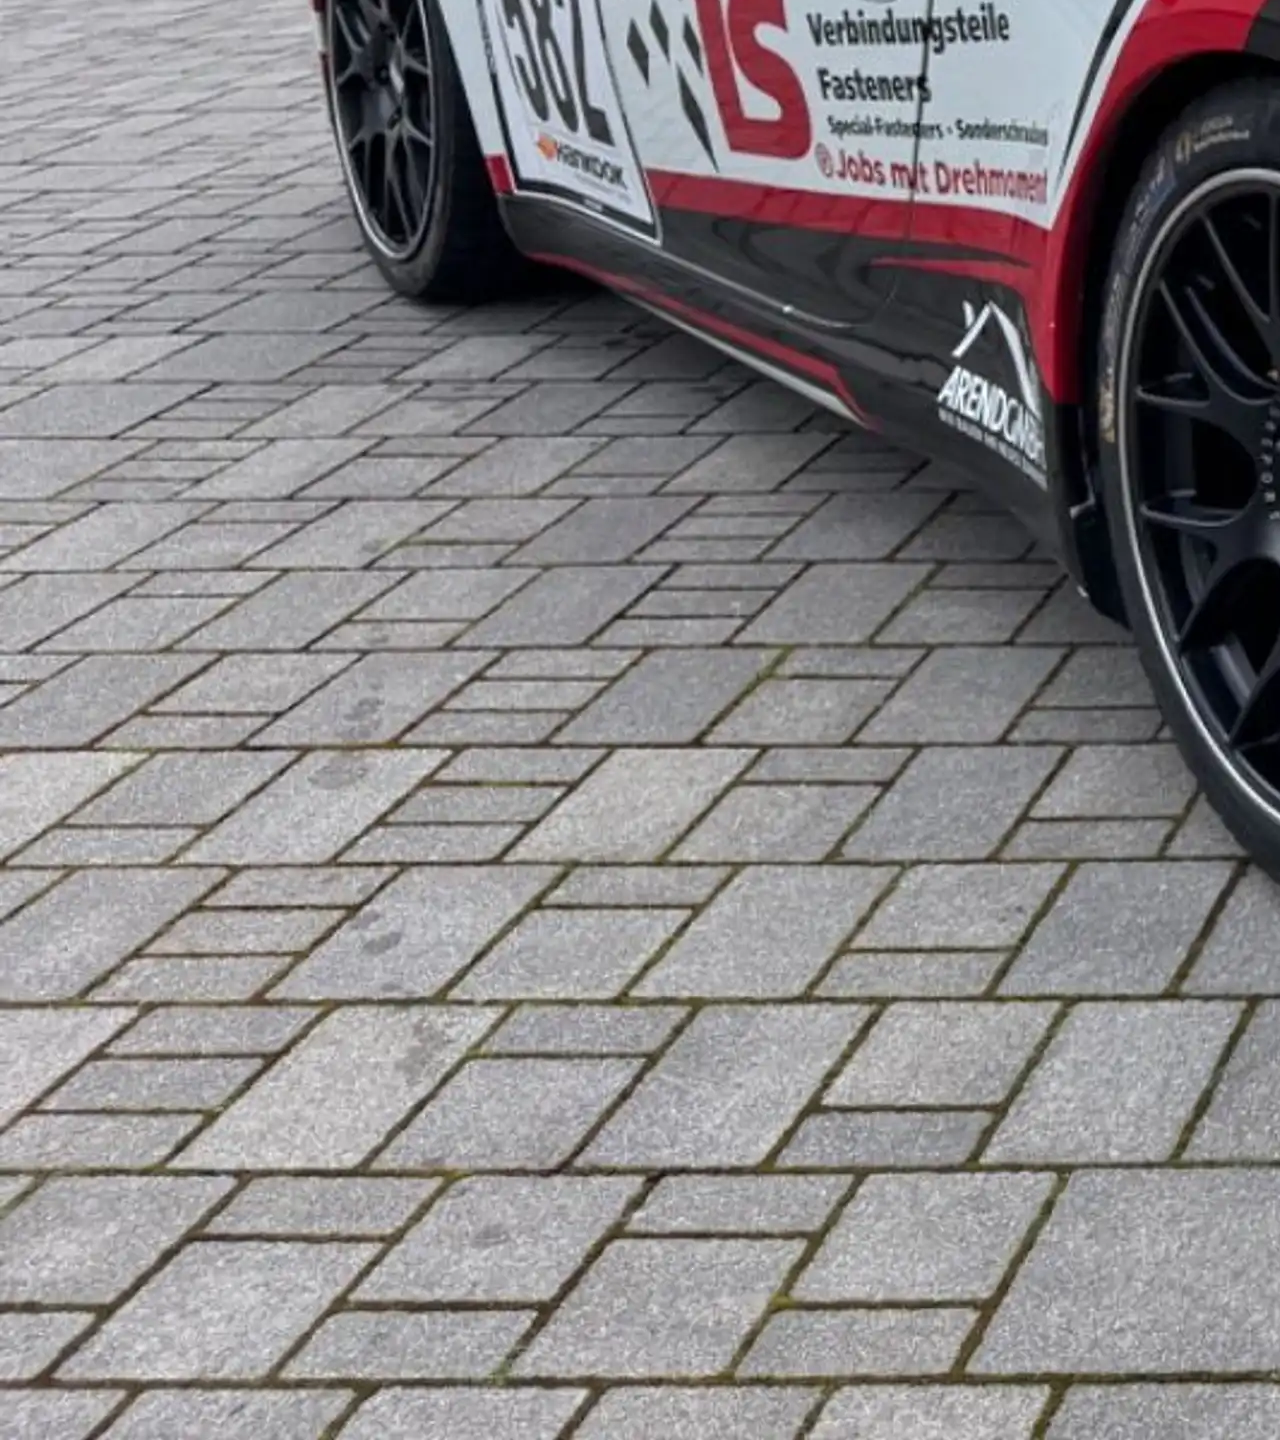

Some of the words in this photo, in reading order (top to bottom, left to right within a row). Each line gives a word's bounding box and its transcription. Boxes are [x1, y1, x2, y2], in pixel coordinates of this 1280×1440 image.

[806, 2, 1010, 54] Verbindungsteile
[816, 67, 932, 103] Fasteners
[837, 150, 885, 185] Jobs
